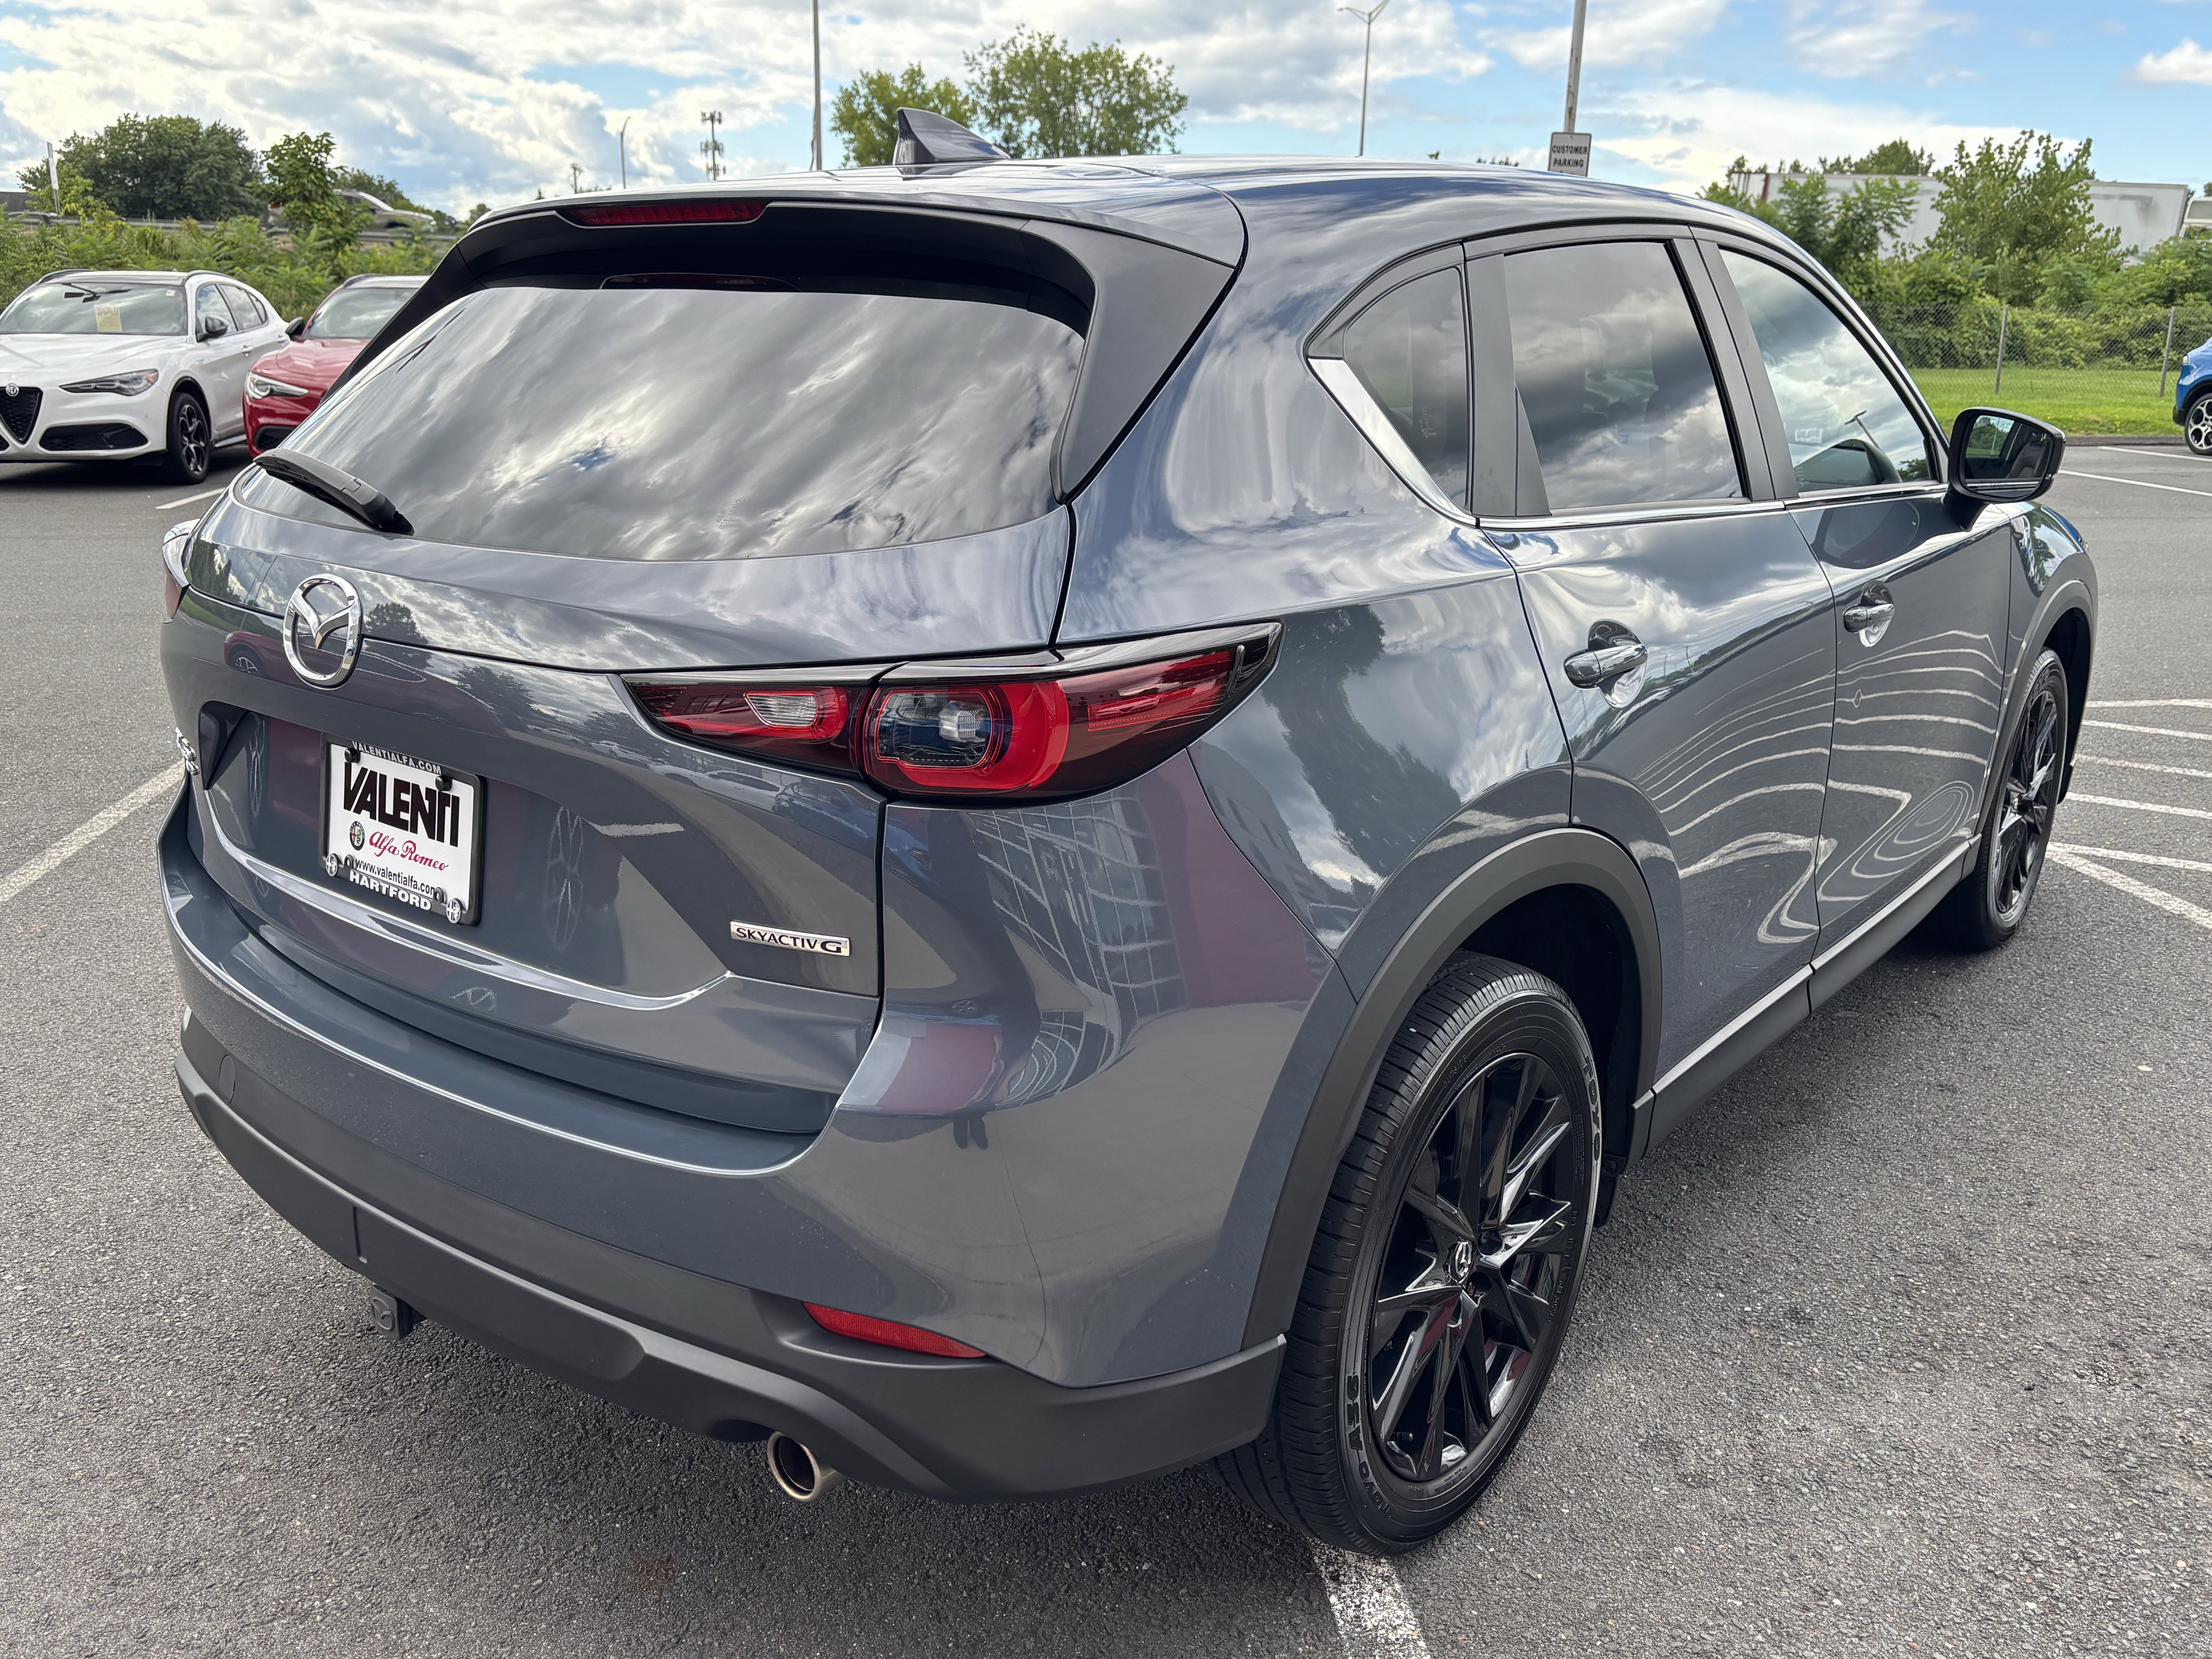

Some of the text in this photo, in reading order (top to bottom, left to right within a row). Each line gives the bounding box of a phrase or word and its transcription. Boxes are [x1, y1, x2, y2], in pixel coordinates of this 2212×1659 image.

[1552, 144, 1587, 155] CUSTOMER
[1553, 158, 1584, 168] PARKING
[352, 741, 441, 775] VALENTIALFA.COM
[343, 761, 460, 847] VALENTI
[369, 831, 448, 871] Alfa Romeo
[350, 871, 431, 911] HARTFORD
[1583, 1054, 1601, 1161] TOYO
